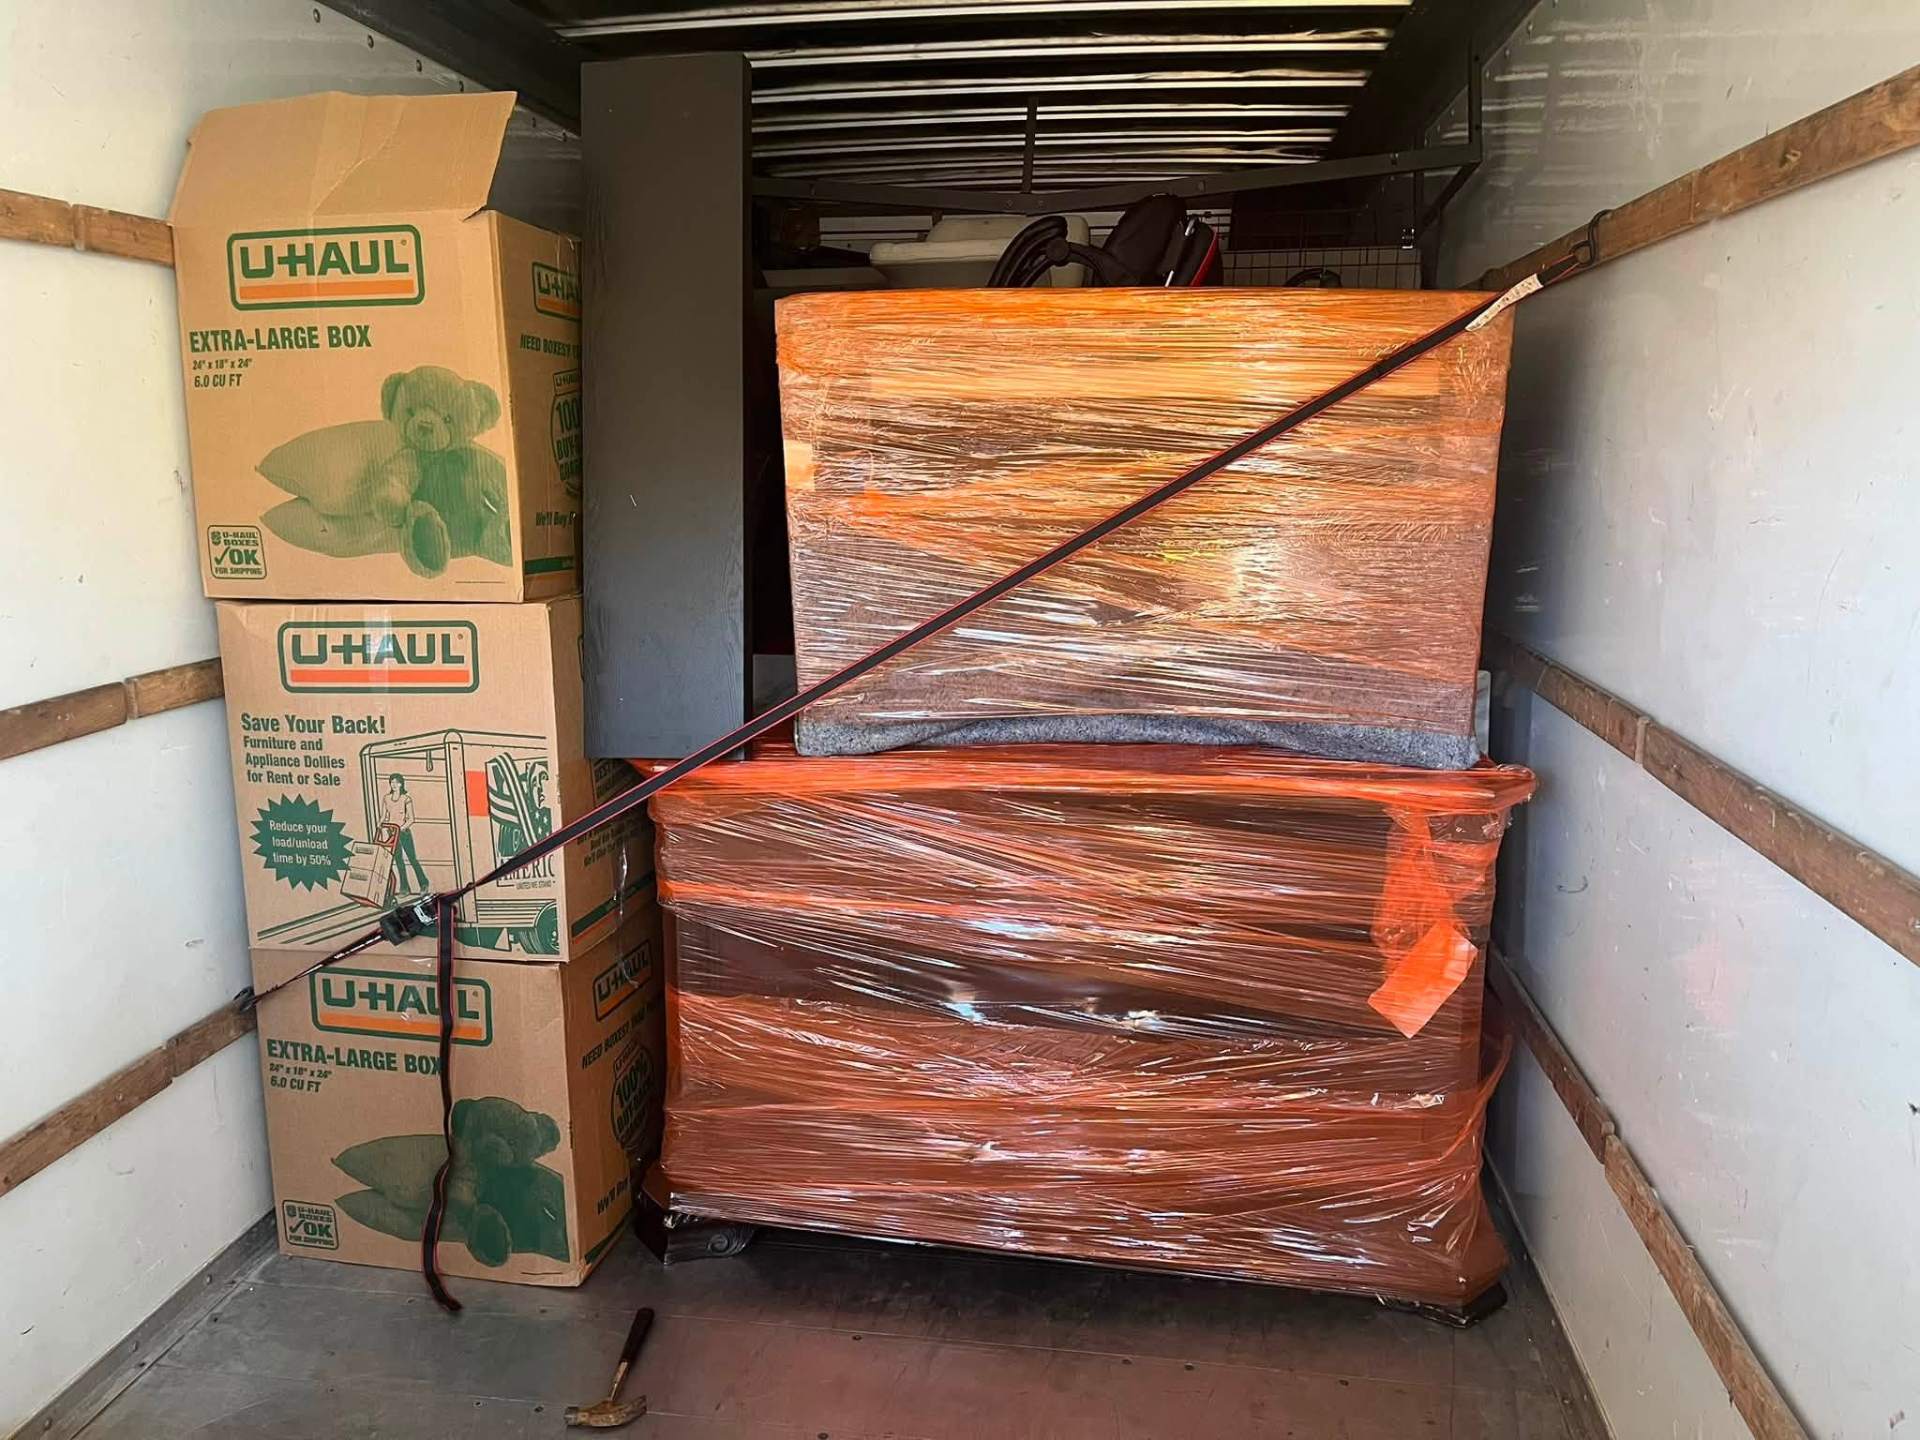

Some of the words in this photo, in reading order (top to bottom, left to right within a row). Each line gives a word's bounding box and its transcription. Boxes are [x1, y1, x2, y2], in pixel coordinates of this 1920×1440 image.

[239, 239, 410, 279] U-HAUL
[536, 270, 580, 304] U-HA
[189, 326, 320, 353] EXTRA-LARGE
[327, 324, 372, 348] BOX
[520, 334, 541, 352] NEED
[194, 374, 210, 388] 6.0
[212, 374, 226, 388] CU
[229, 373, 243, 387] FT
[556, 397, 580, 433] 100
[229, 548, 262, 566] OK
[291, 633, 465, 665] U-HAUL
[240, 712, 280, 732] Save
[285, 714, 325, 734] Your
[331, 715, 386, 734] Back!
[243, 735, 297, 750] Furniture
[300, 738, 323, 751] and
[245, 753, 300, 769] Appliance
[304, 754, 345, 769] Dollies
[247, 770, 263, 783] for
[267, 771, 293, 785] Rent
[297, 775, 310, 785] or
[313, 773, 341, 786] Sale
[269, 820, 303, 832] Reduce
[306, 823, 328, 835] your
[272, 836, 329, 850] load/unload
[273, 852, 294, 864] time
[296, 853, 307, 866] by
[309, 854, 332, 866] 50%
[266, 1038, 398, 1071] EXTRA-LARGE
[404, 1053, 442, 1076] BOX
[270, 1075, 287, 1088] 6.0
[289, 1077, 304, 1091] CU
[306, 1080, 321, 1093] FT
[303, 1222, 333, 1238] OK
